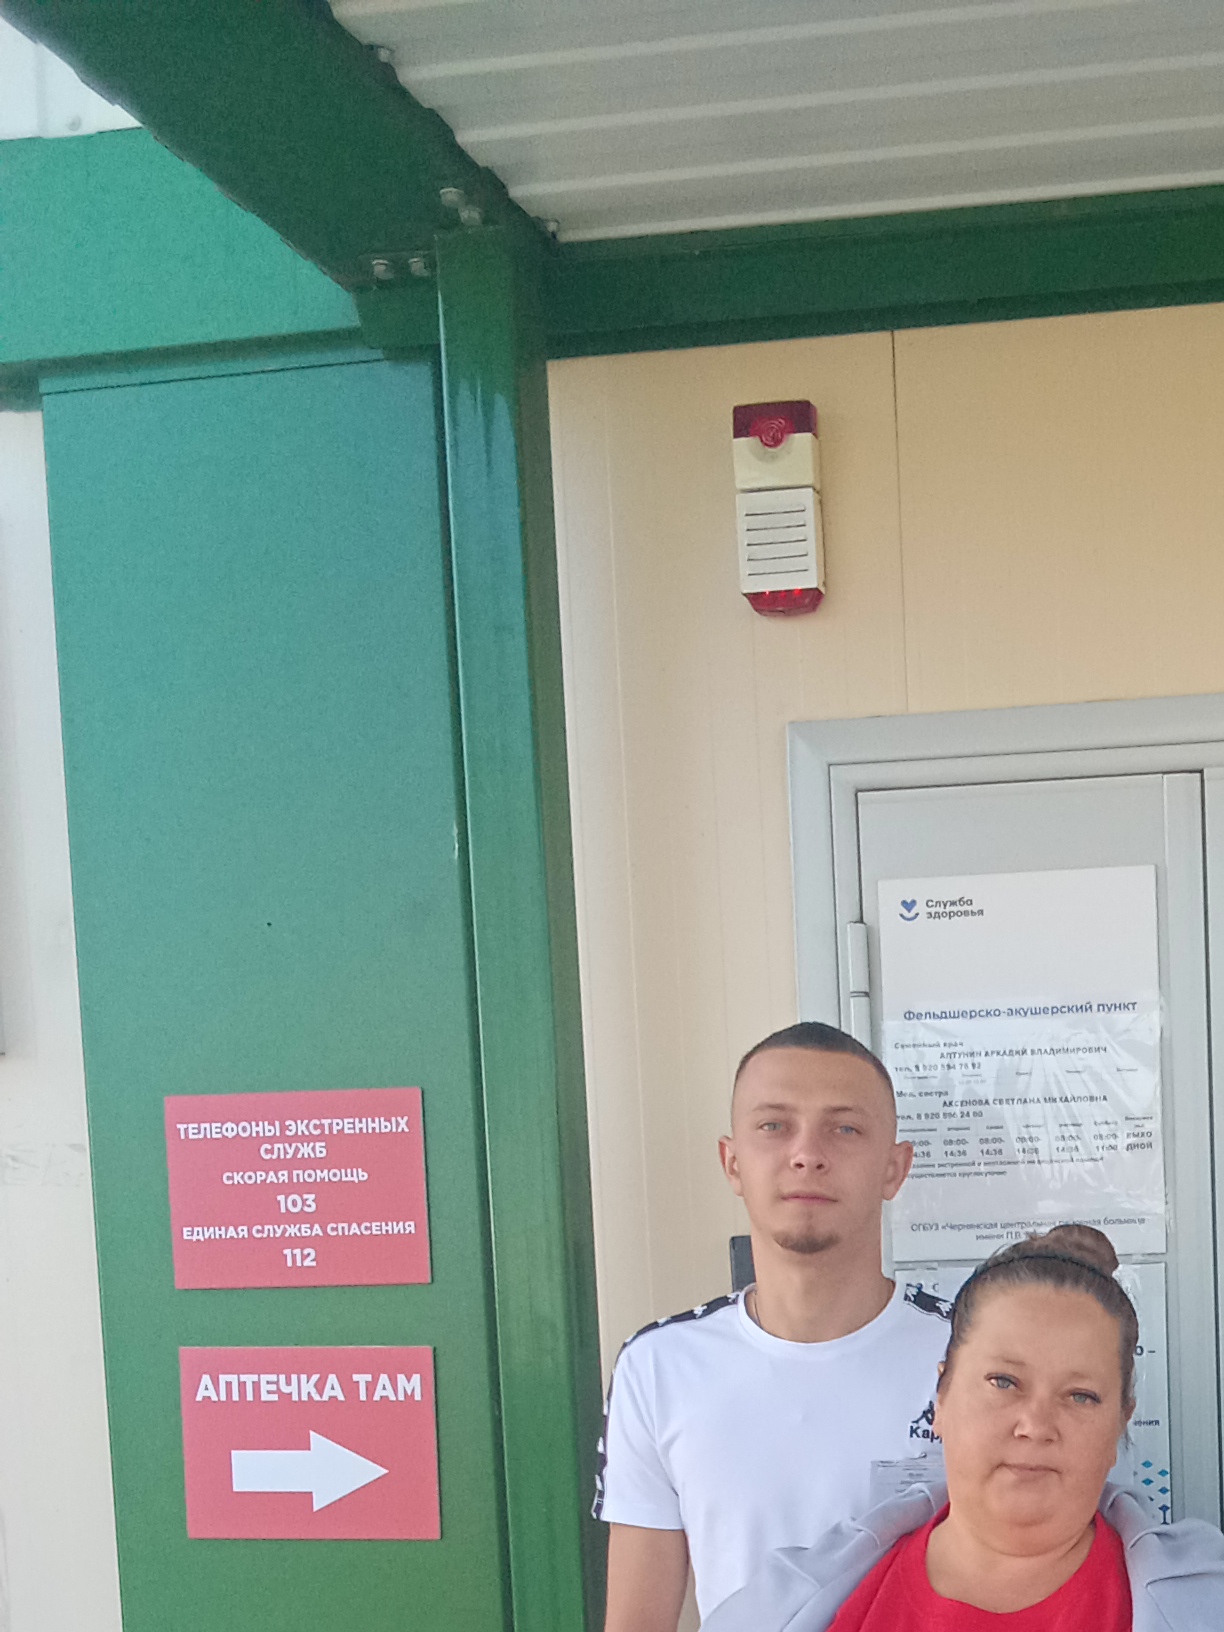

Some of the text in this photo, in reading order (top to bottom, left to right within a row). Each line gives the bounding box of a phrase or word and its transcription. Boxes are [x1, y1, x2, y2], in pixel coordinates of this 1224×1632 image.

[925, 897, 974, 910] Служба
[926, 909, 985, 921] здоровья
[903, 1001, 1138, 1022] Фельдшерско-акушерский пункт
[984, 1047, 1028, 1058] АРКАДИЙ
[1030, 1046, 1107, 1057] ВЛАДИМИРОВИЧ
[943, 1095, 1109, 1109] АКСЕНОВА СВЕТЛАНА МИХАЙЛОВНА
[176, 1116, 409, 1140] ТЕЛЕФОНЫ ЭКСТРЕННЫХ
[259, 1142, 327, 1160] СЛУЖБ
[222, 1168, 368, 1185] СКОРАЯ ПОМОЩЬ
[276, 1194, 316, 1213] 103
[182, 1221, 416, 1241] ЕДИНАЯ СЛУЖБА СПАСЕНИЯ
[283, 1248, 316, 1267] 112
[195, 1373, 422, 1402] АПТЕЧКА ТАМ
